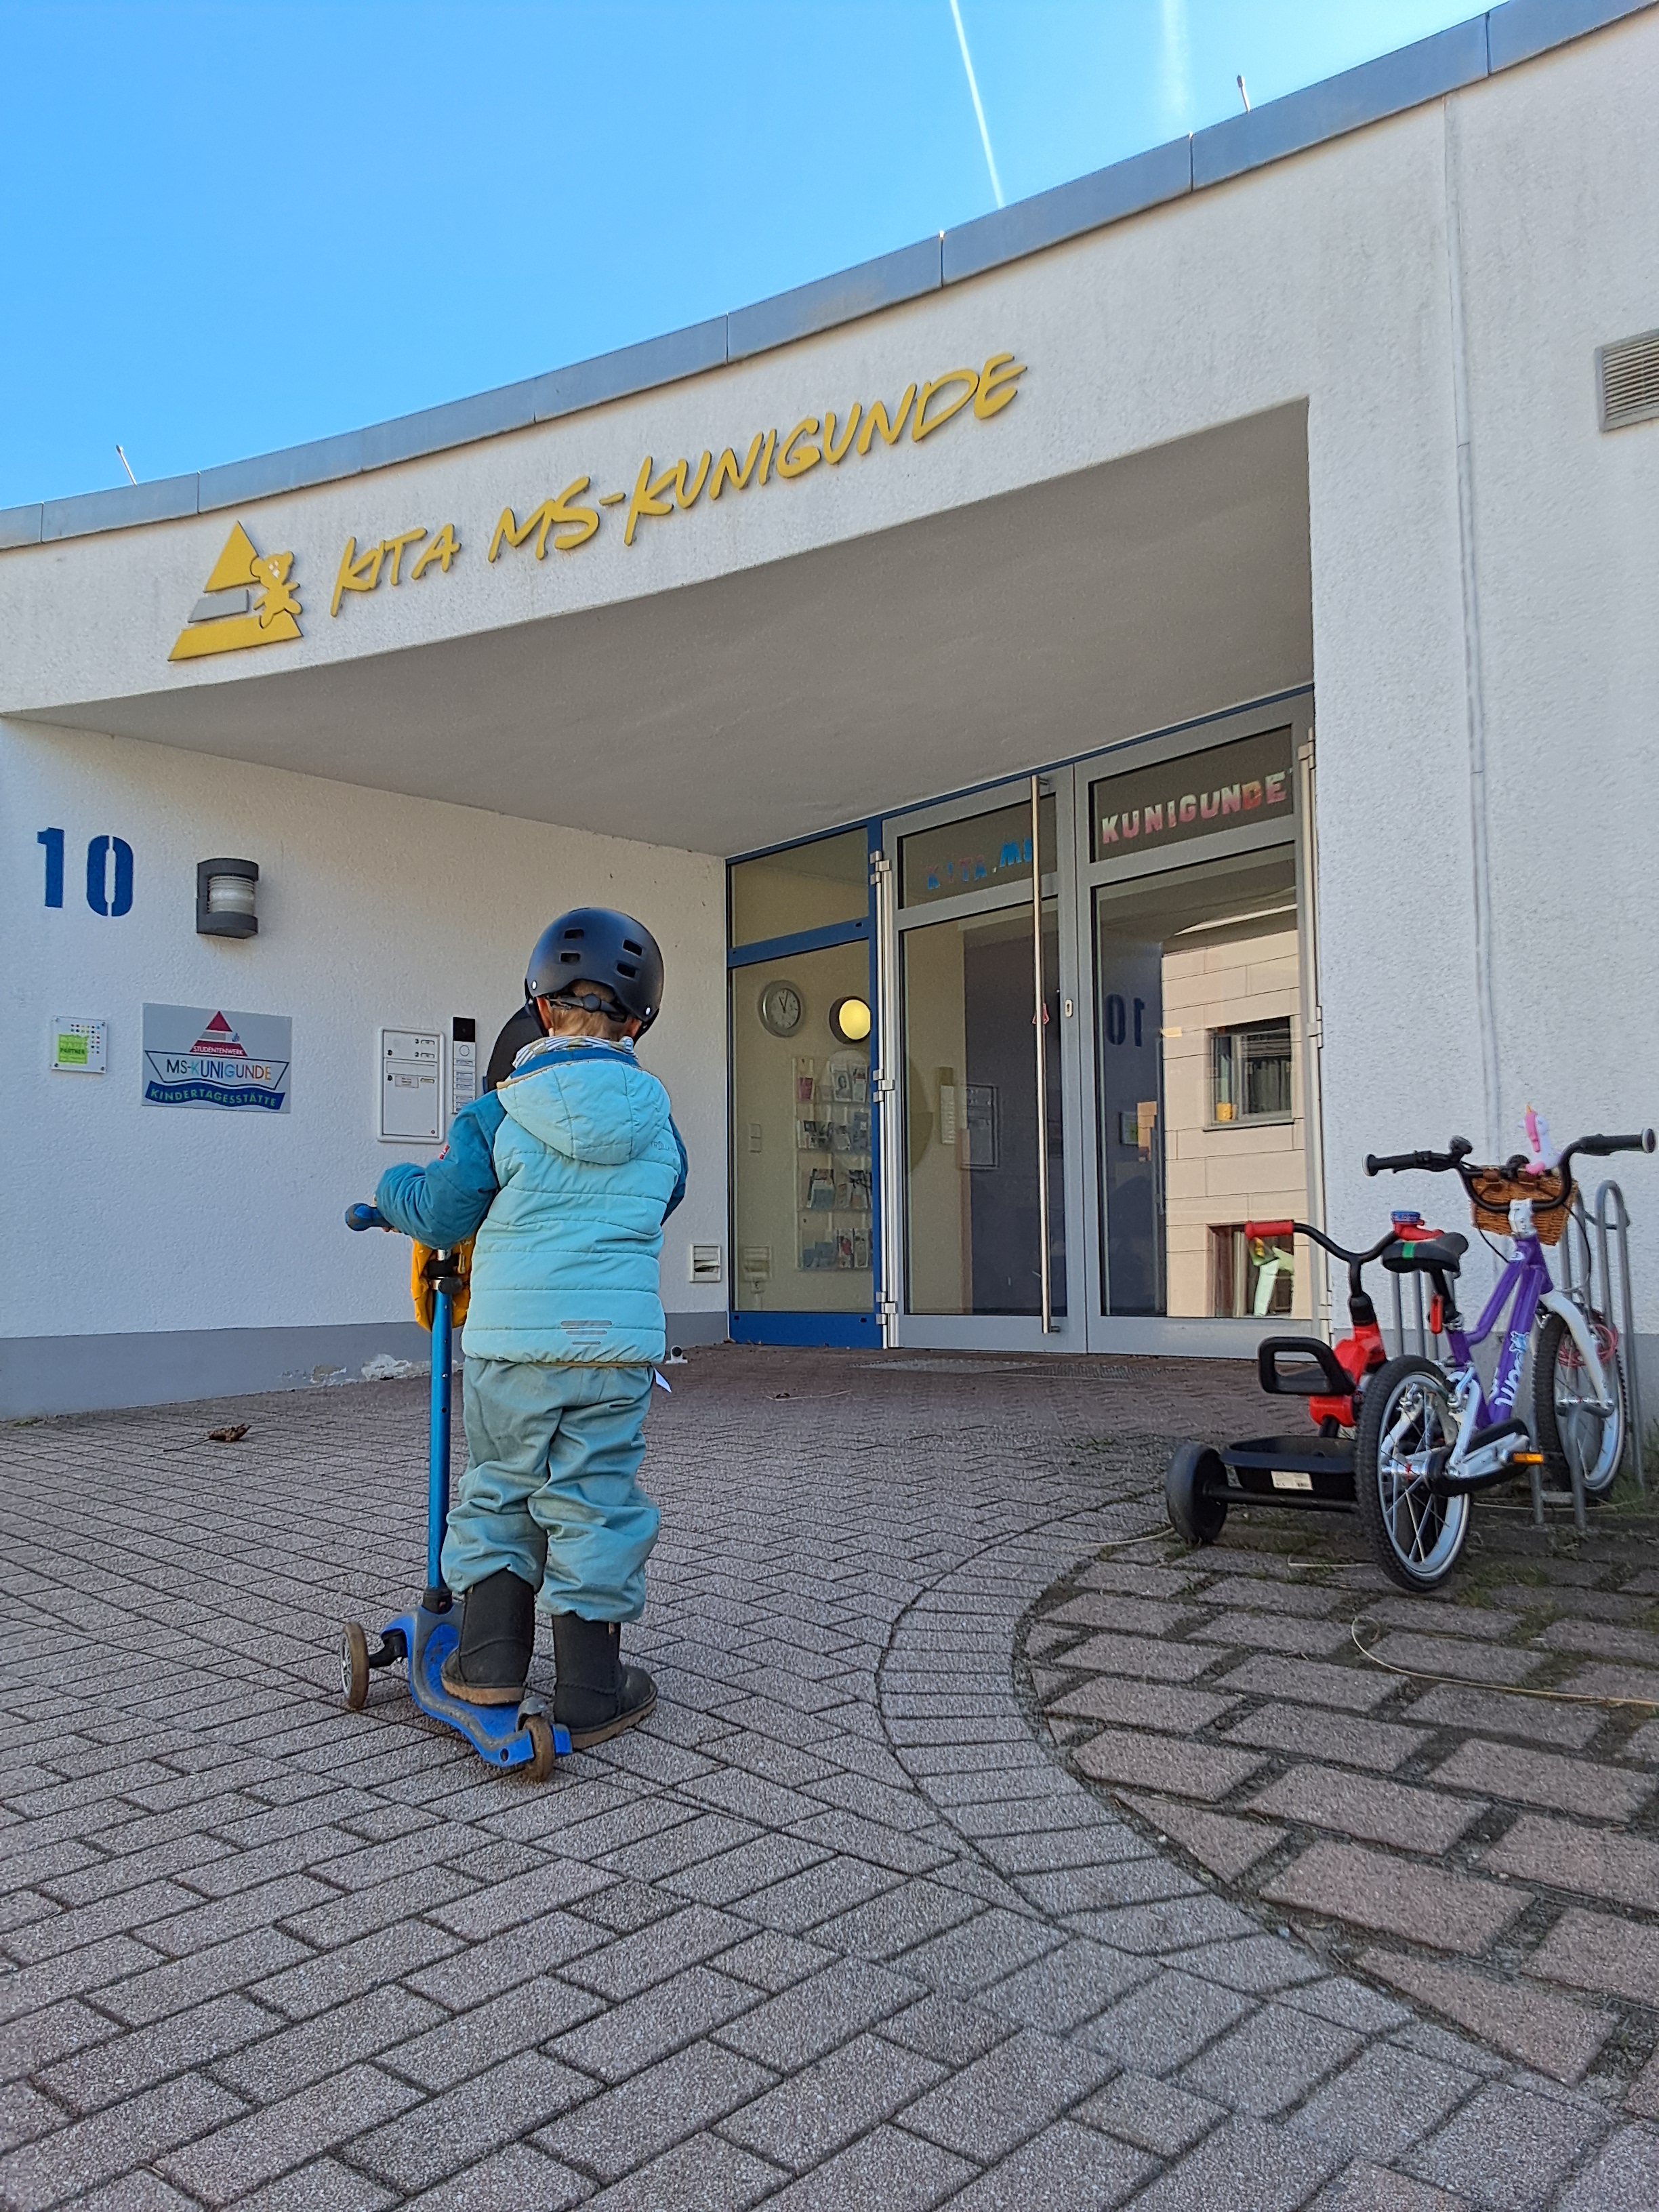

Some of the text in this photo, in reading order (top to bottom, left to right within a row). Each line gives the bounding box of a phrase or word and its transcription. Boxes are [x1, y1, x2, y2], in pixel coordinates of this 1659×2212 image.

[331, 352, 1027, 618] KITA MS-KUNIGUNDE
[1101, 771, 1286, 844] KUNIGUNDE
[37, 827, 134, 917] 10
[166, 1059, 272, 1081] MS-KUNIGUNDE
[193, 1046, 244, 1056] STUDENTENWERK
[150, 1088, 276, 1107] KINDERTAGESSTÄTTE
